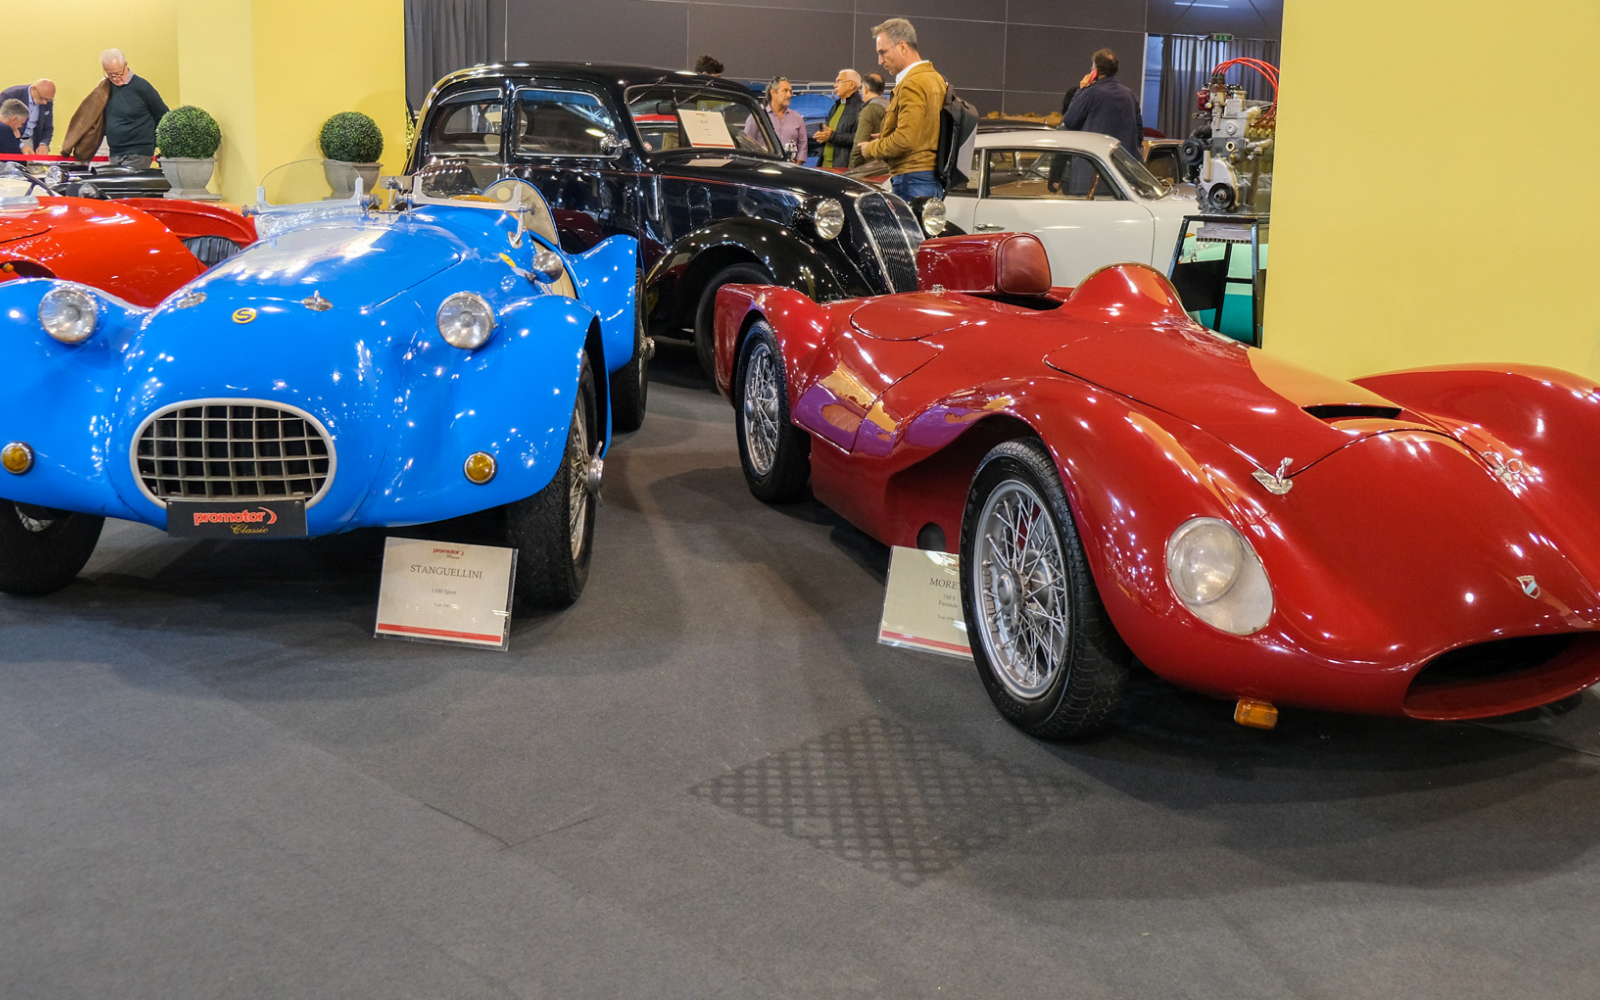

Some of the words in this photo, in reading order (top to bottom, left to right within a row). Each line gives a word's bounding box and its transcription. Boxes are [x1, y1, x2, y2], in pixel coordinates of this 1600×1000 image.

[193, 509, 267, 526] promotor
[230, 523, 269, 535] Classic
[433, 547, 460, 556] promotor
[410, 564, 483, 579] STANGUELLINI
[929, 577, 960, 590] MORE
